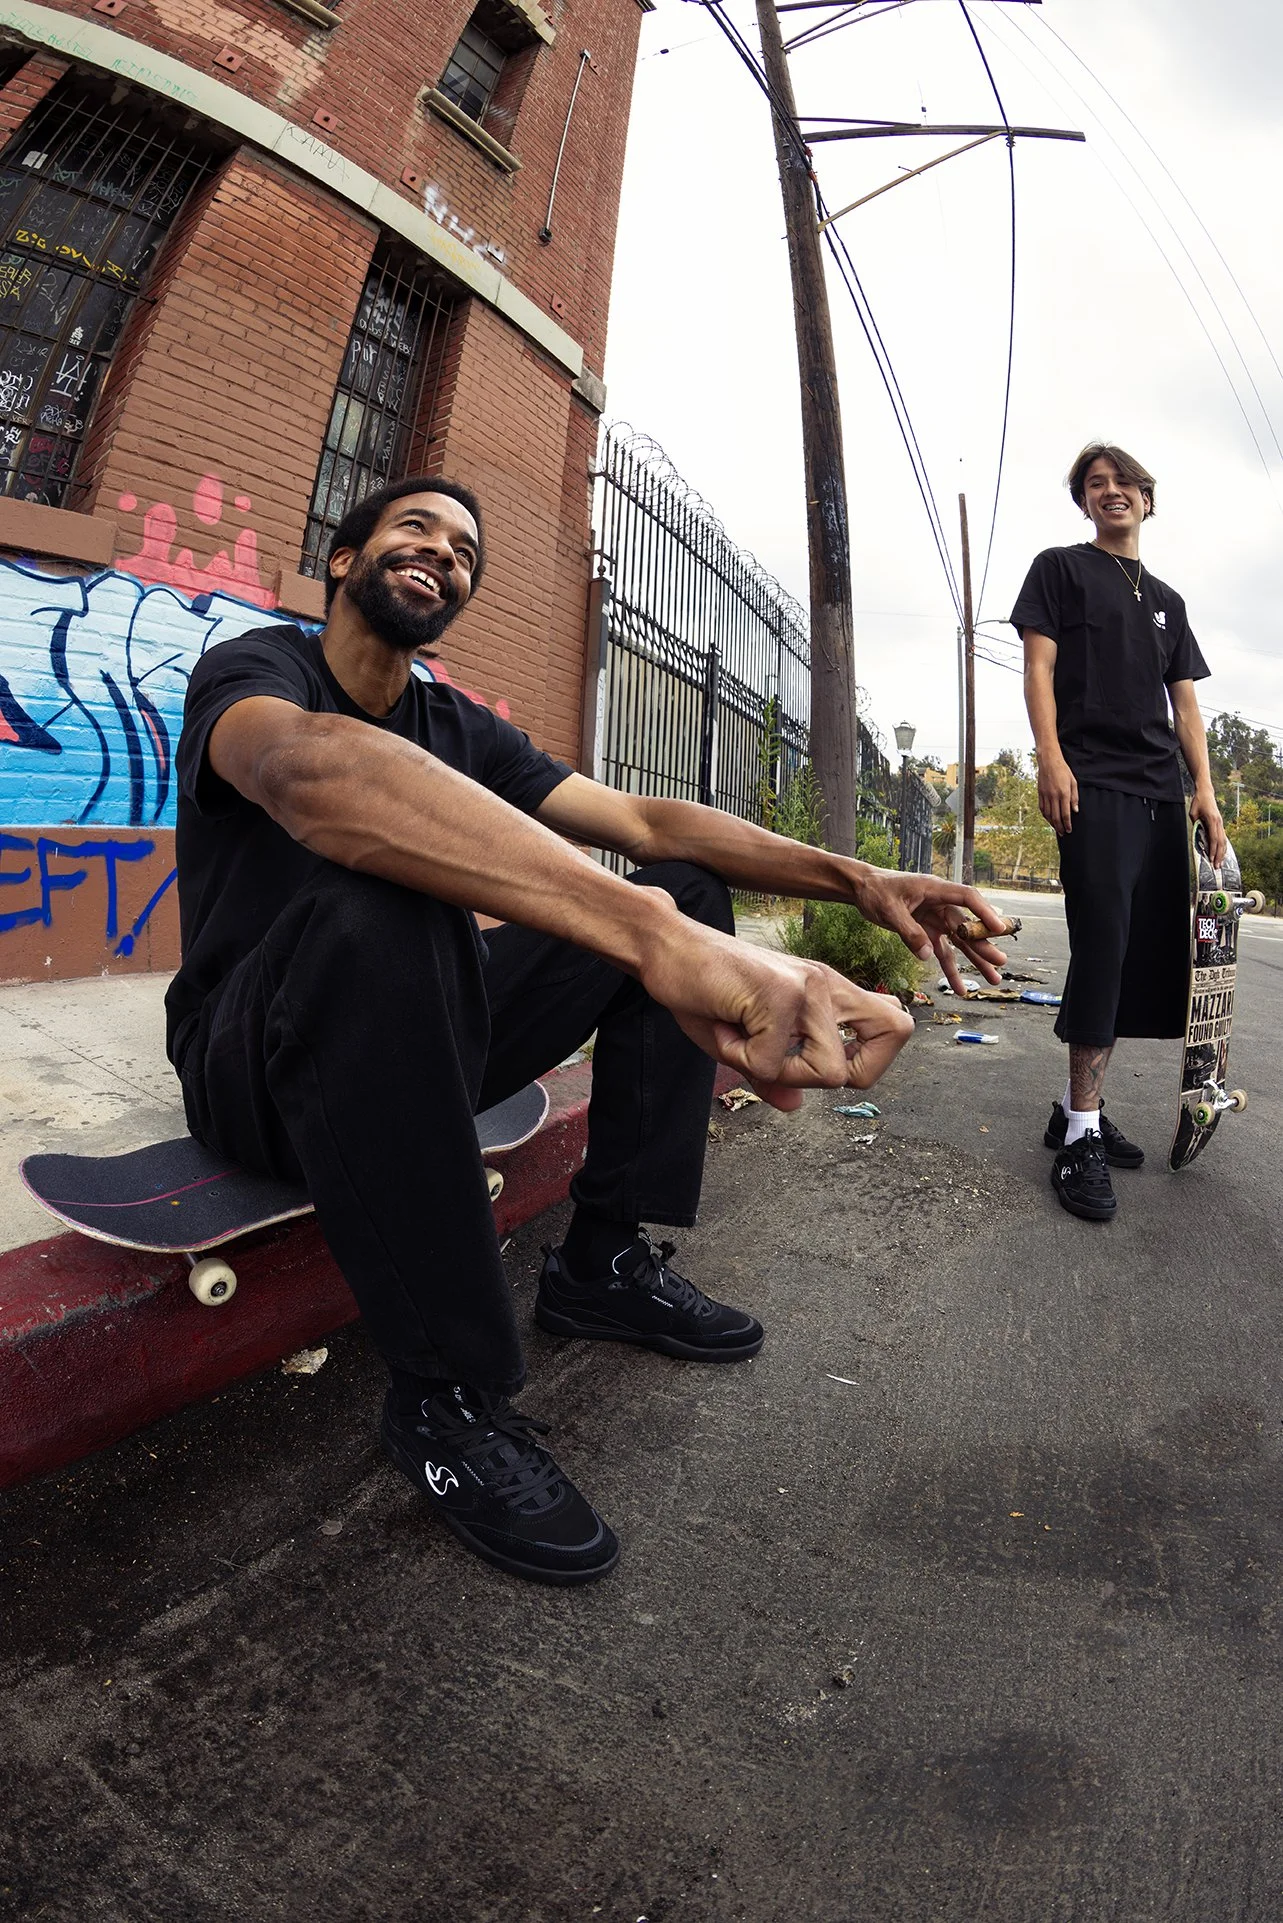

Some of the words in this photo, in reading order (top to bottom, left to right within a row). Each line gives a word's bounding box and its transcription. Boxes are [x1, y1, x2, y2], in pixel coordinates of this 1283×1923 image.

[1198, 918, 1216, 929] TECH
[1199, 928, 1217, 940] DECK
[1187, 1022, 1213, 1043] FOUND
